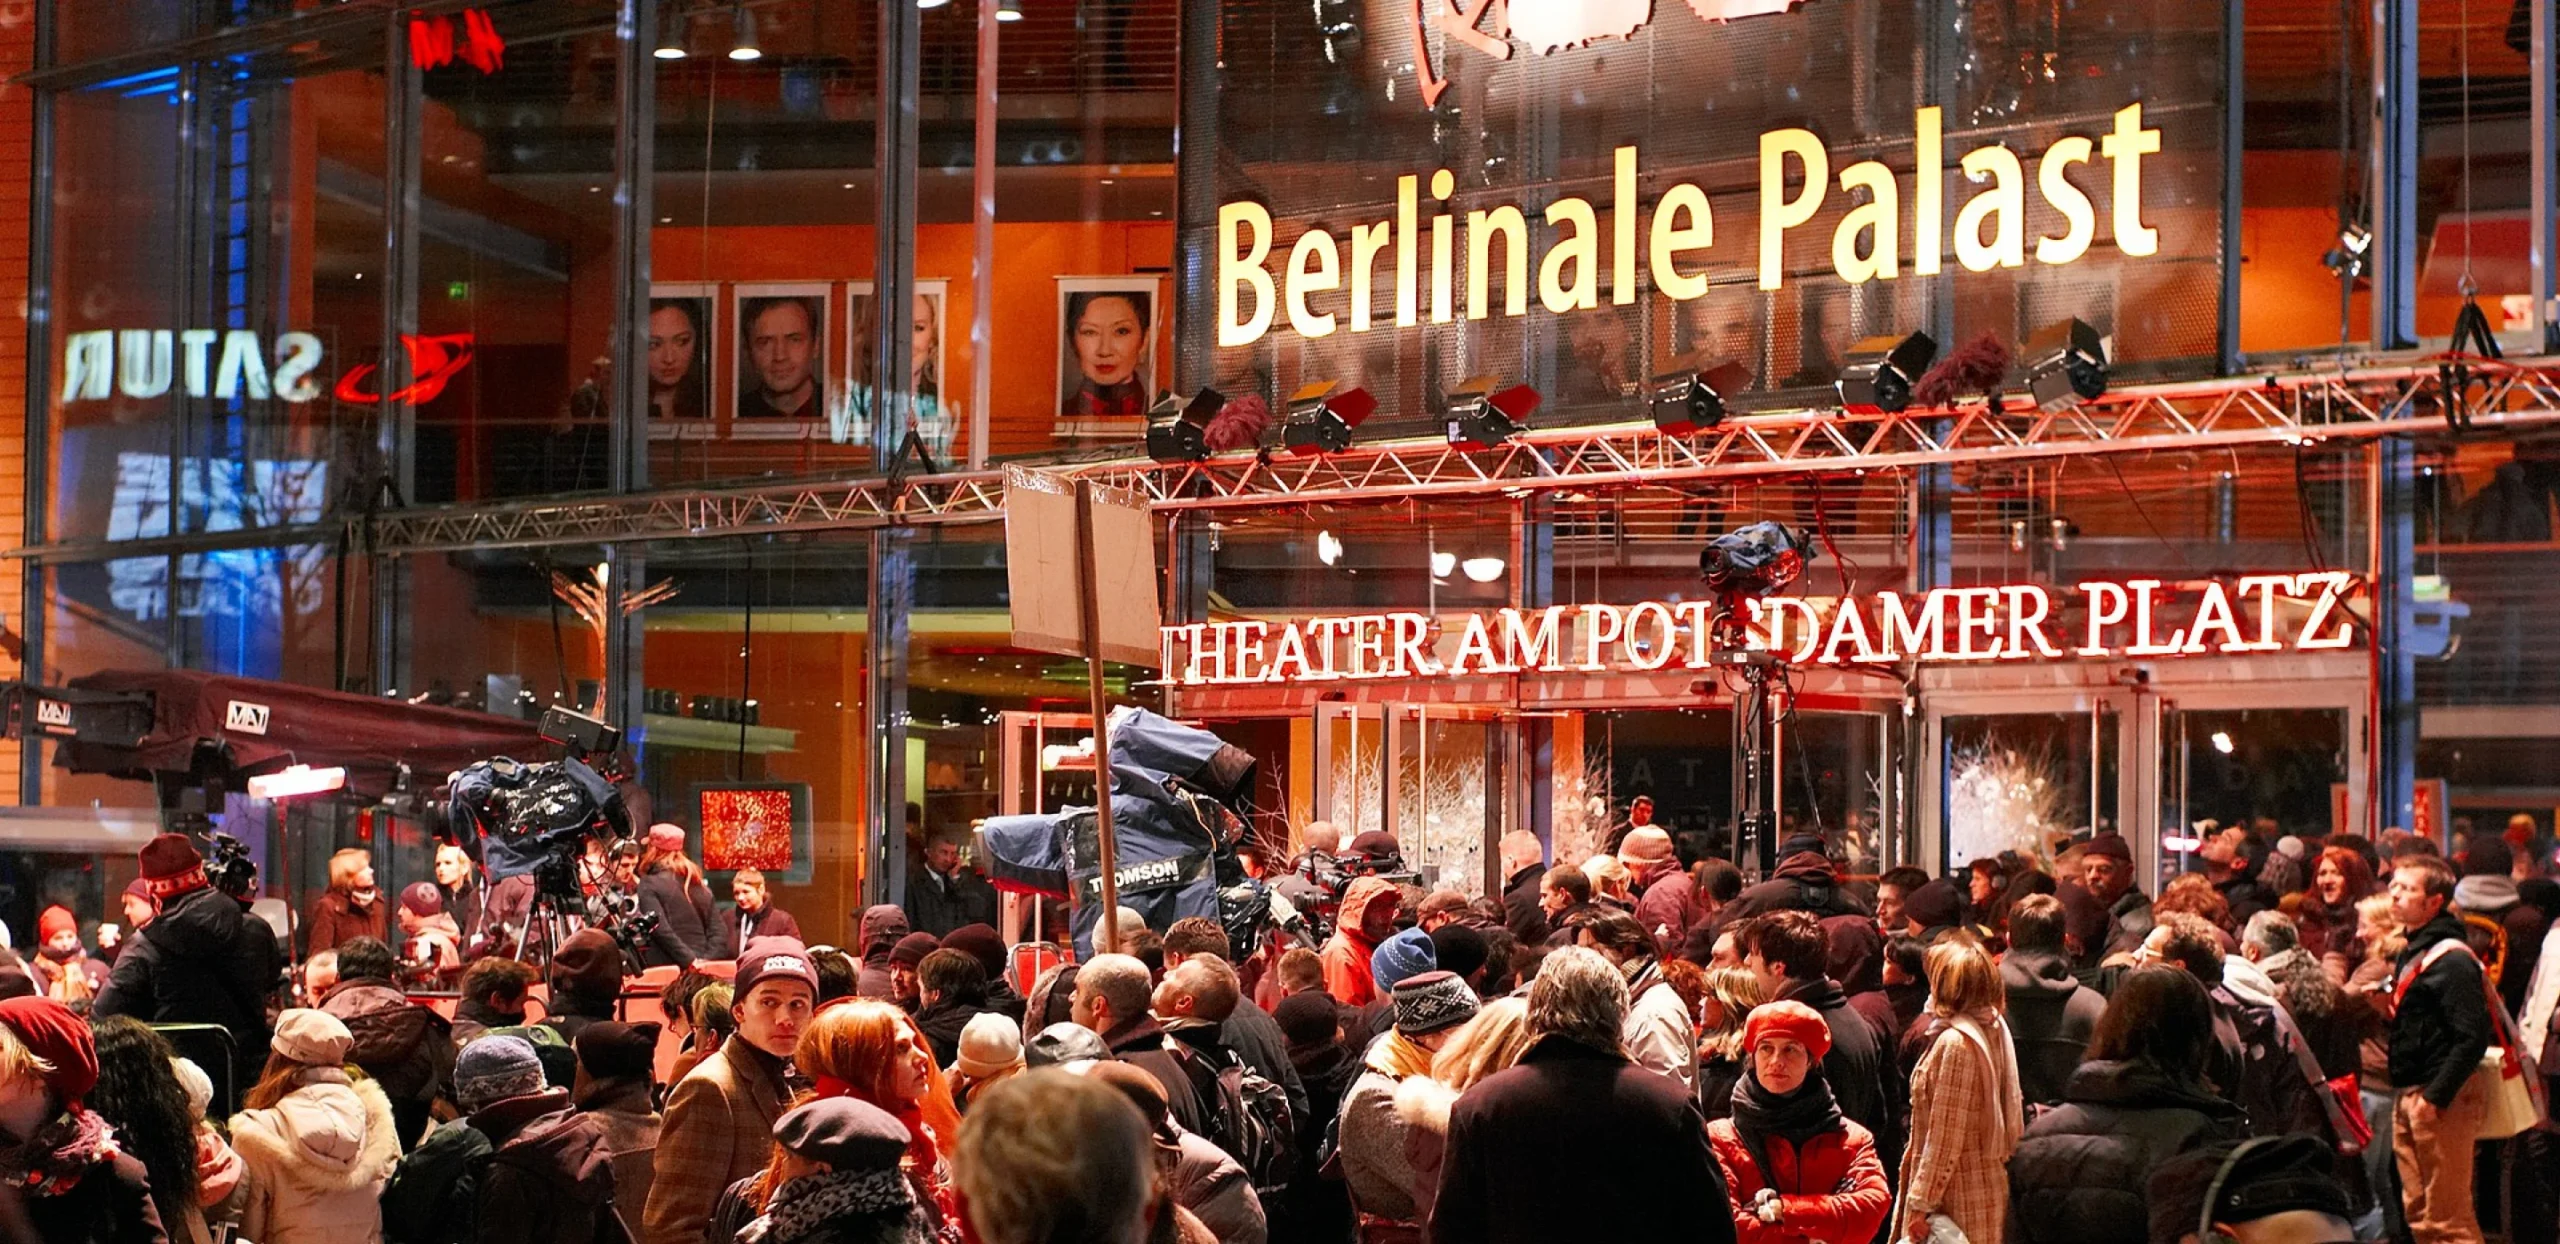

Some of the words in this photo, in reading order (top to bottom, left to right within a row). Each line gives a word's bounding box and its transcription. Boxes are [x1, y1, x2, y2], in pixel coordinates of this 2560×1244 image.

[1216, 145, 1713, 347] Berlinale
[1758, 102, 2161, 290] Palast
[1157, 611, 1438, 684] THEATER
[1448, 605, 1566, 676] AM
[2077, 571, 2352, 657] PLATZ
